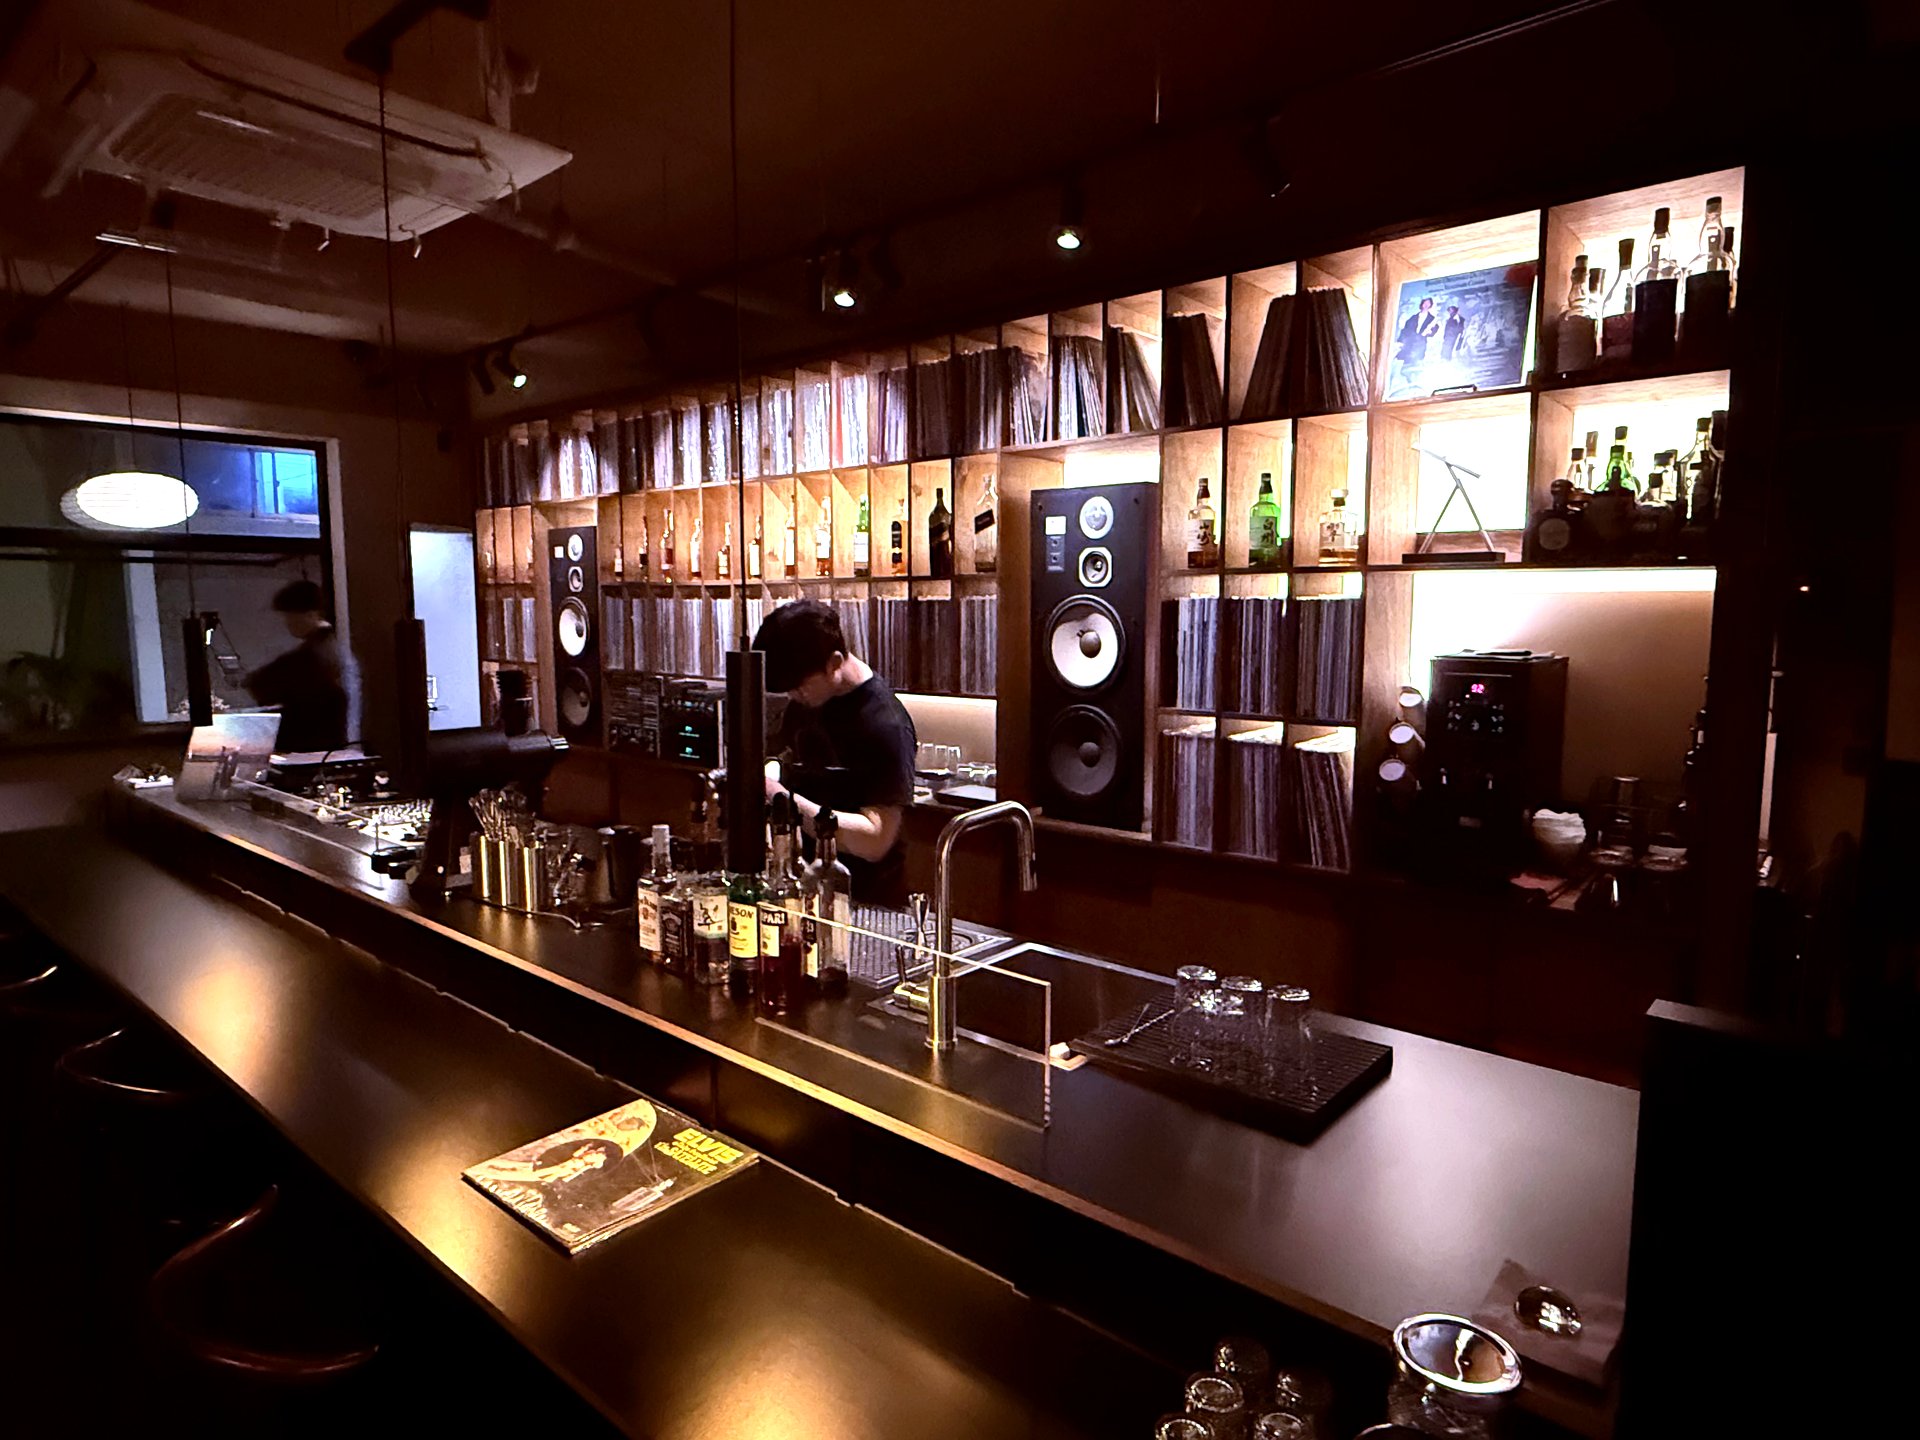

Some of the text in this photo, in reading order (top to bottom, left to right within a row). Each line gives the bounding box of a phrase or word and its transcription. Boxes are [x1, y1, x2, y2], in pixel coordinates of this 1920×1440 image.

[729, 905, 754, 919] ESON
[761, 911, 785, 925] PARI
[673, 1128, 744, 1164] ELVIS
